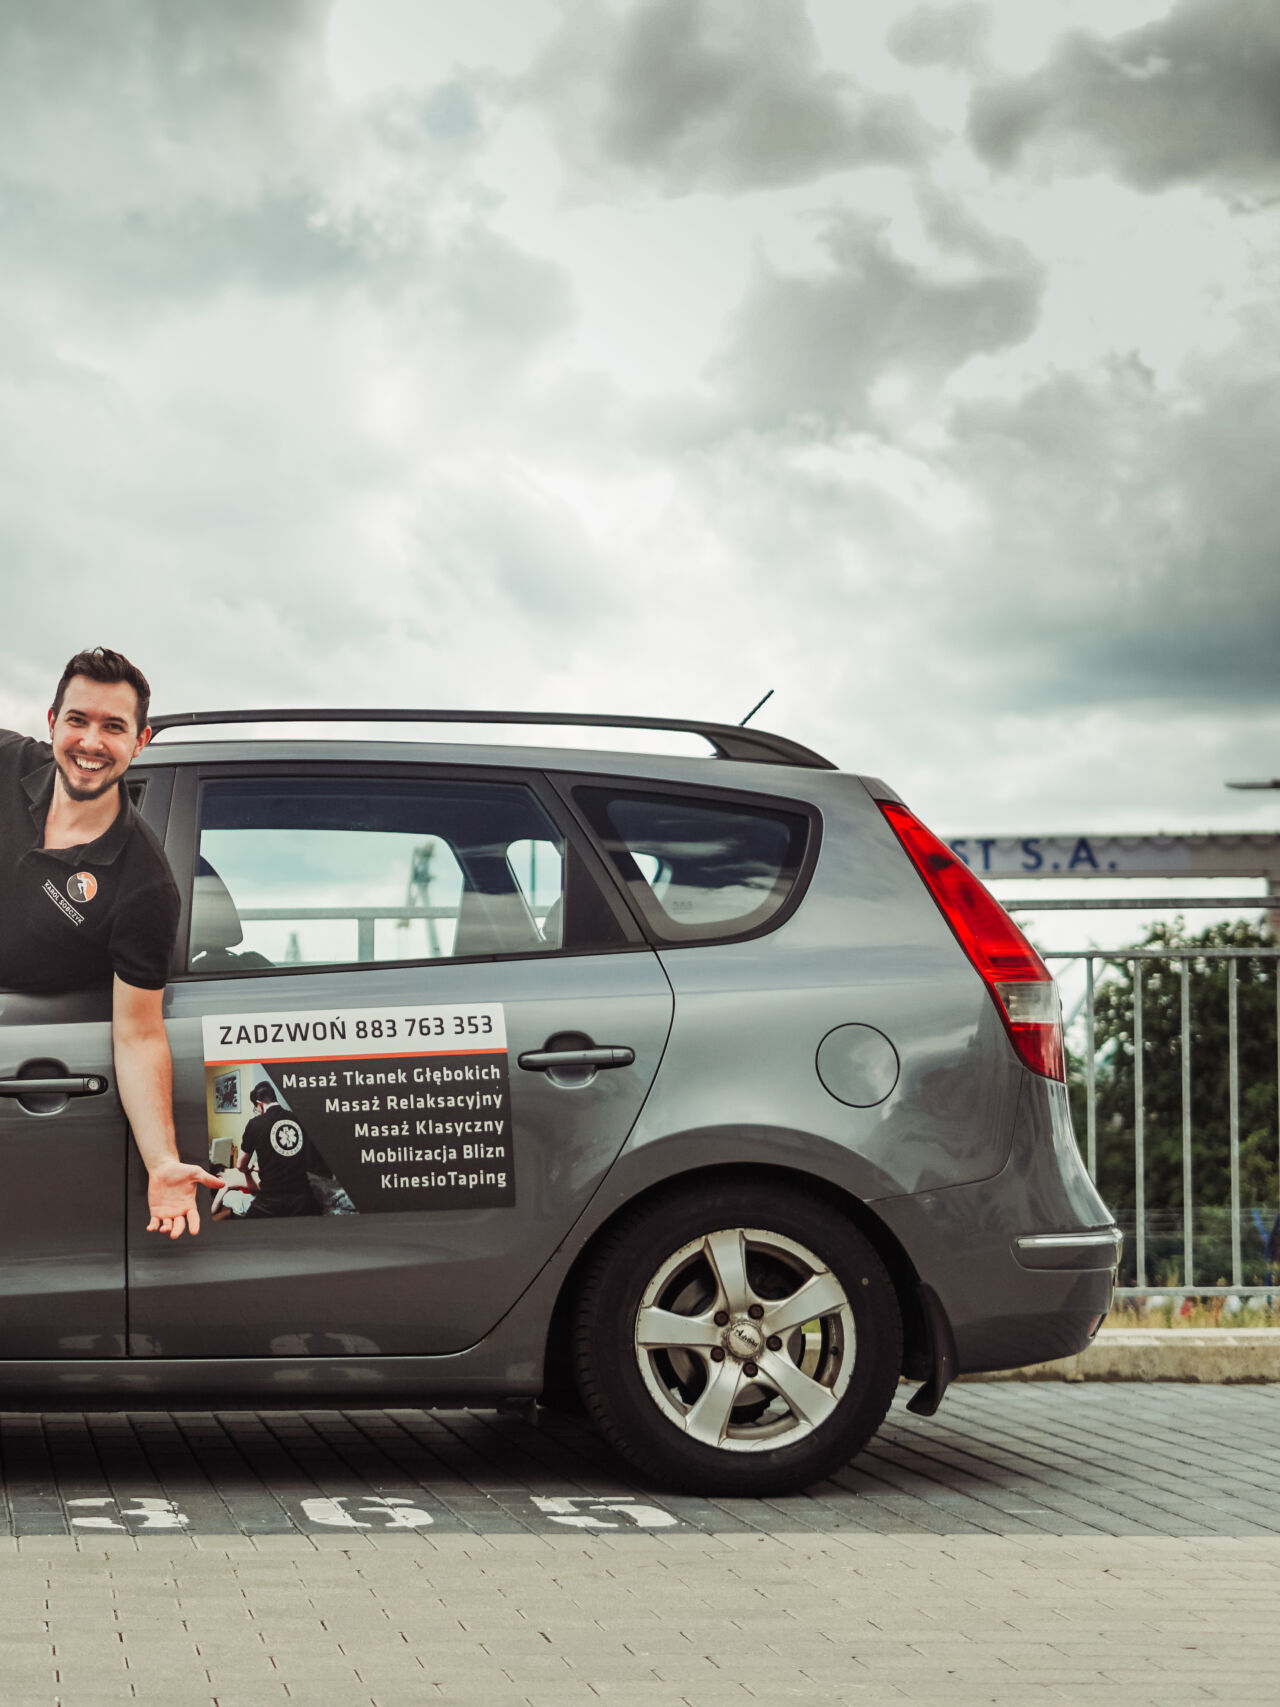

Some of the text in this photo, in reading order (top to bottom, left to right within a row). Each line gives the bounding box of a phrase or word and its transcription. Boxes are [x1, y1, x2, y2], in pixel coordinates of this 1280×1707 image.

[1022, 837, 1117, 871] S.A.
[44, 882, 83, 924] KAROL SOBCZYK
[219, 1014, 493, 1045] ZADZWOŃ 883 763 353
[282, 1064, 501, 1089] Masaż Tkanek Głębokich
[325, 1091, 504, 1113] Masaż Relaksacyjny
[354, 1118, 505, 1138] Masaż Klasyczny
[361, 1142, 505, 1164] Mobilizacja Blizn
[381, 1168, 507, 1189] KinesioTaping
